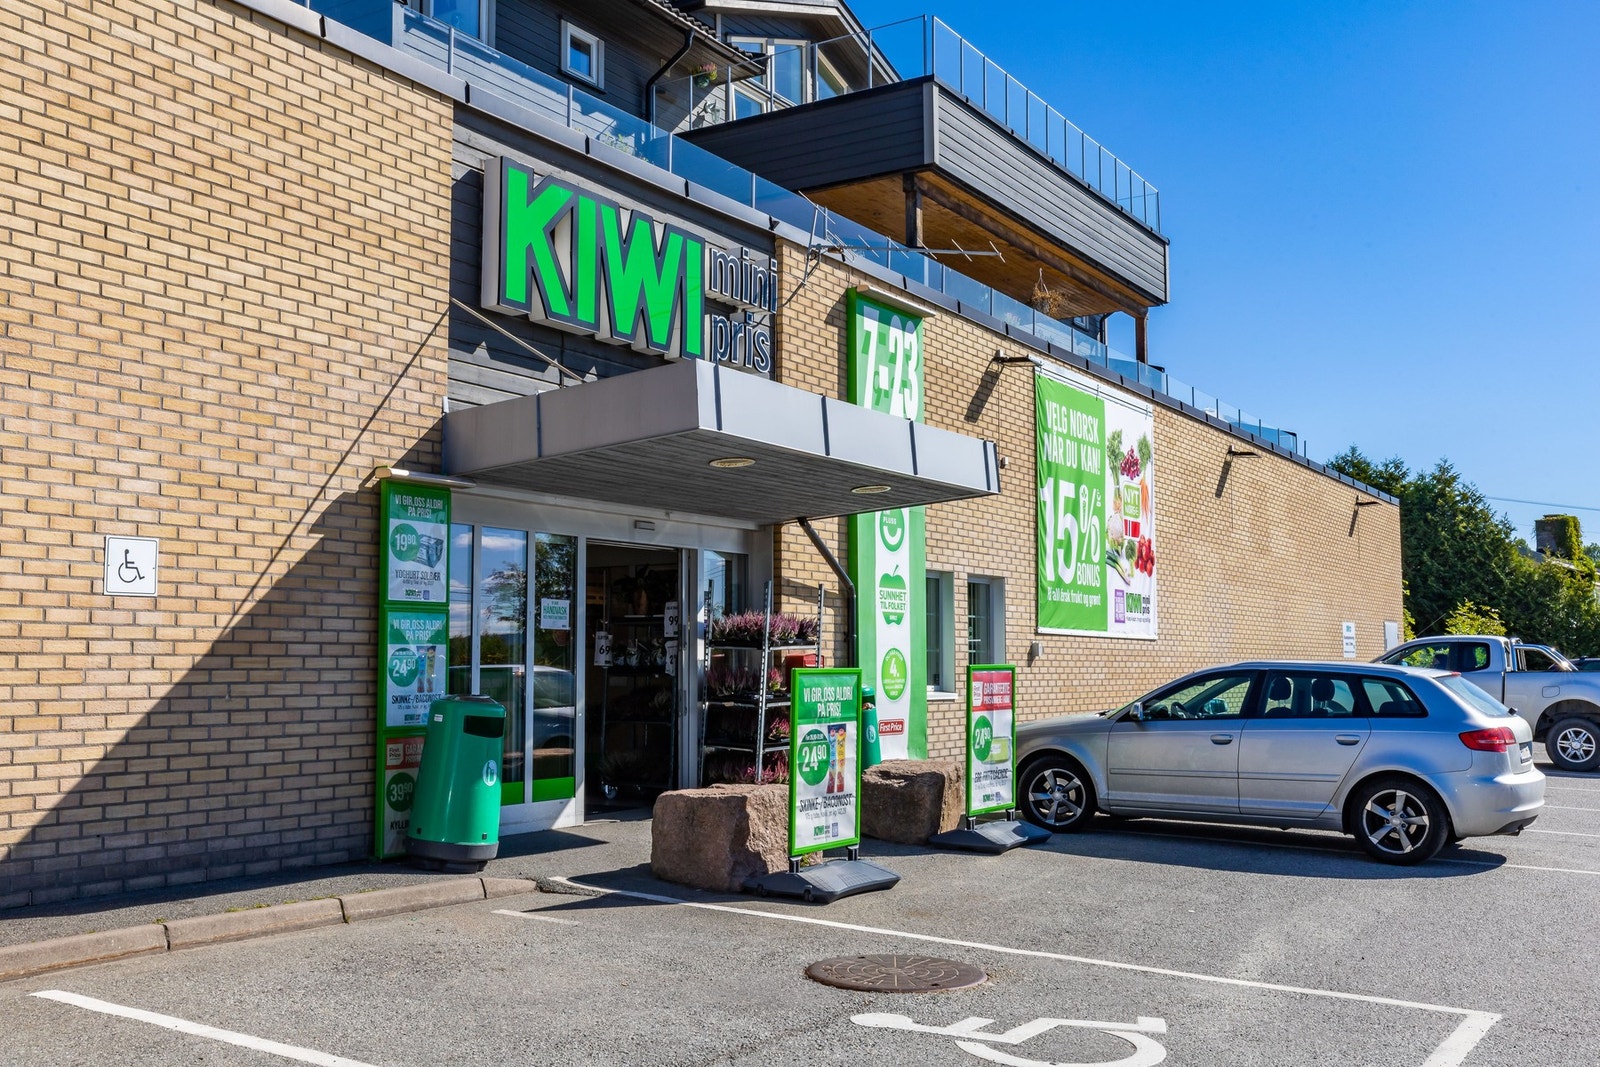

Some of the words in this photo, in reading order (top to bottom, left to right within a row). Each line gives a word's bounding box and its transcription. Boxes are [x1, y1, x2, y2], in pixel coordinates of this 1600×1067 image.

[504, 163, 702, 359] KIWI
[711, 246, 778, 314] mini
[711, 312, 771, 373] pris
[862, 304, 919, 421] 7-23
[1045, 399, 1068, 435] VELG
[1069, 408, 1100, 445] NORSK
[1044, 429, 1065, 466] NÅR
[1066, 439, 1078, 470] DU
[1080, 443, 1101, 476] KAN!
[395, 494, 402, 505] VI
[426, 498, 444, 510] ALDRI
[1124, 487, 1140, 506] NYT
[1040, 477, 1100, 585] 15%
[395, 569, 420, 580] YOGHURT
[1076, 562, 1101, 587] BONUS
[879, 590, 906, 601] SUNNHET
[1126, 592, 1142, 614] KIWI
[880, 601, 888, 610] TIL
[888, 601, 906, 611] FOLKET
[668, 615, 679, 626] 99
[599, 645, 610, 656] 69
[803, 687, 811, 703] VI
[811, 687, 822, 703] GIR
[823, 686, 835, 702] OSS
[836, 686, 853, 701] ALDRI
[826, 702, 842, 718] PRIS!
[880, 723, 891, 732] First
[891, 722, 903, 732] Price
